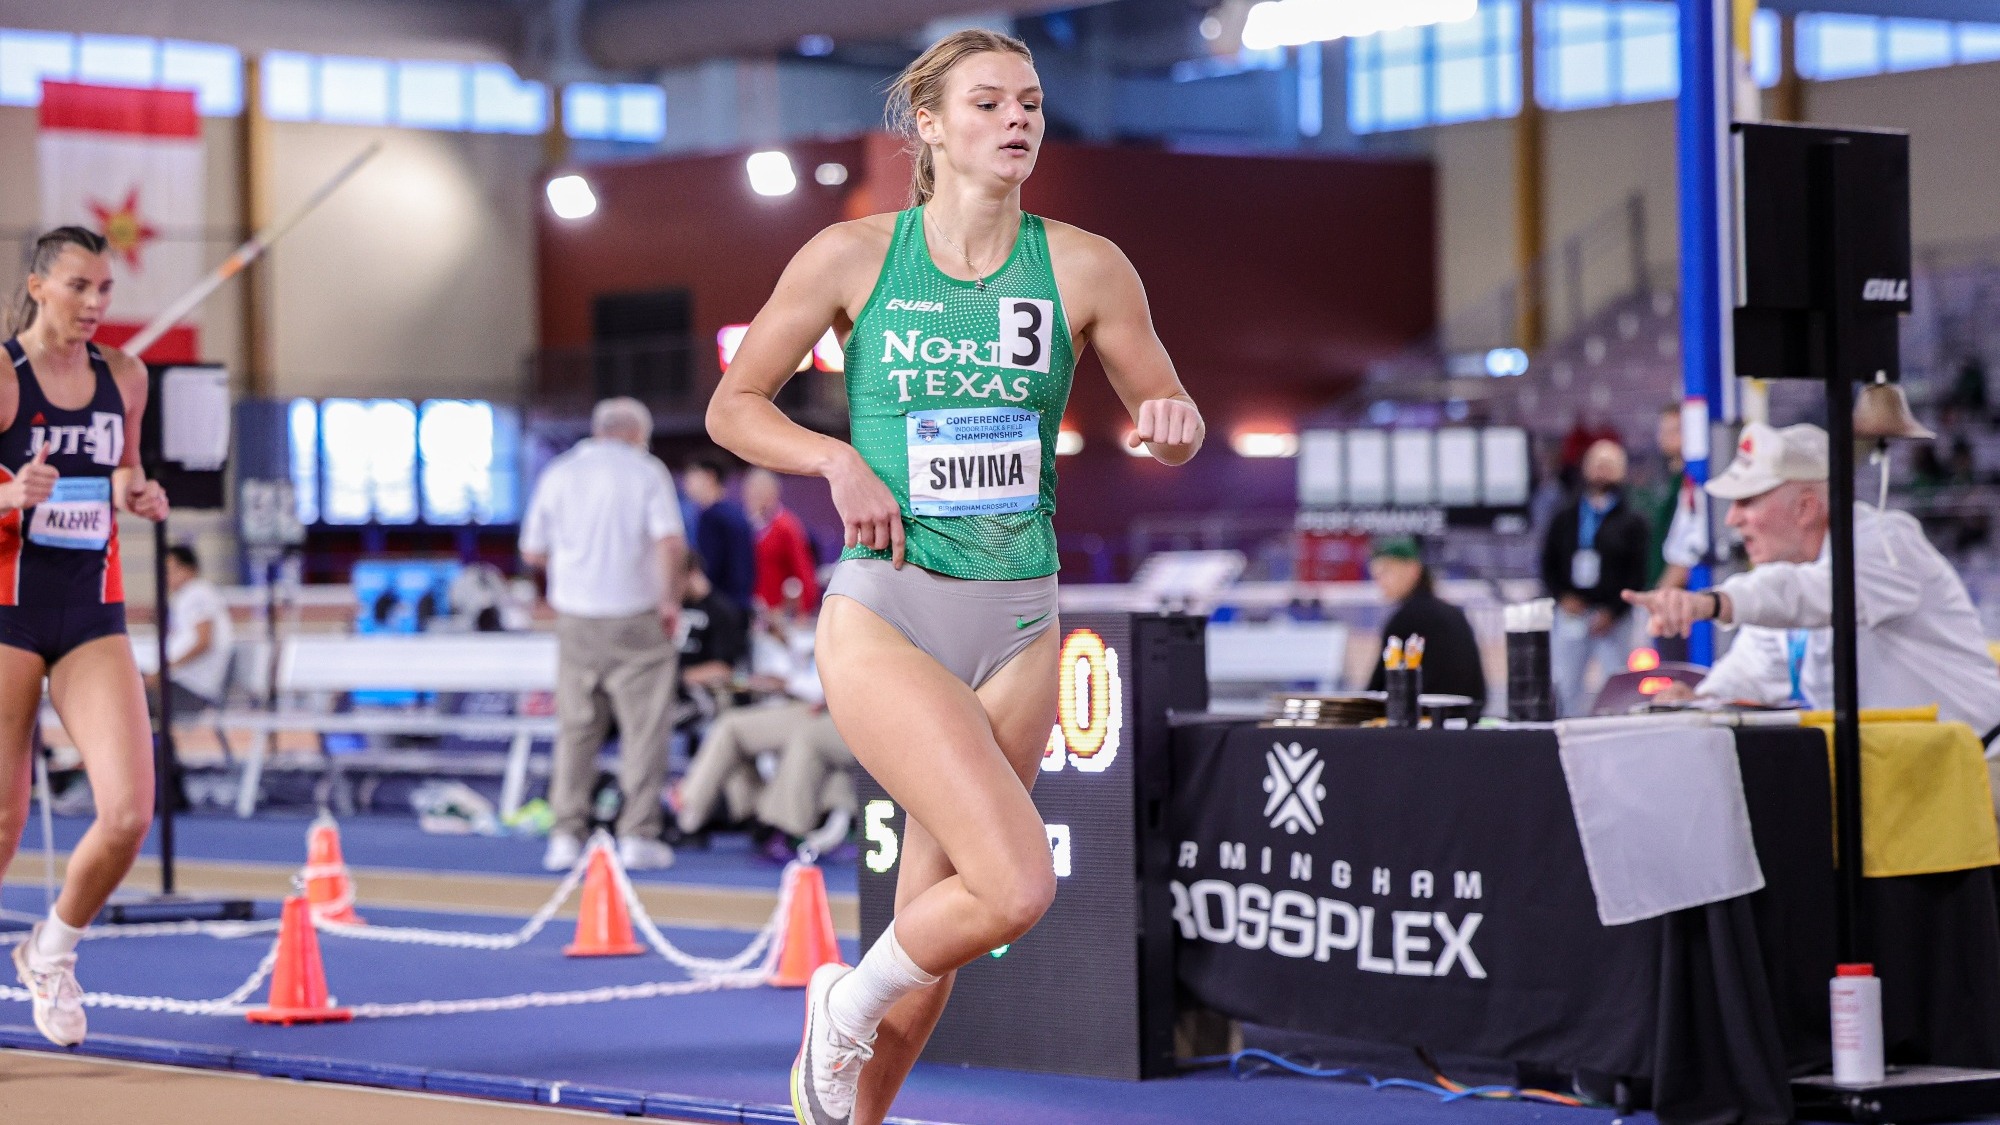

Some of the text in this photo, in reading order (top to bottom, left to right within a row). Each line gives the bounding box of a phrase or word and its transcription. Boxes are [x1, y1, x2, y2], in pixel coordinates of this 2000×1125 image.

[1862, 278, 1908, 301] GILL
[881, 329, 1001, 366] NORT
[1012, 302, 1042, 366] 3
[888, 369, 1031, 403] TEXAS
[946, 414, 1032, 425] CONFERENCE USA
[955, 425, 979, 433] INDOOR
[981, 424, 1000, 432] TRACK
[955, 430, 1023, 441] CHAMPIONSHIPS
[26, 425, 95, 456] UTS
[104, 420, 114, 460] 1
[930, 453, 1025, 490] SIVINA
[938, 501, 1019, 512] BIRMINGHAM CROSSPLEX
[1043, 629, 1122, 772] 0
[865, 800, 898, 872] 5
[1178, 841, 1483, 899] RMINGHAM
[1170, 879, 1488, 979] ROSSPLEX
